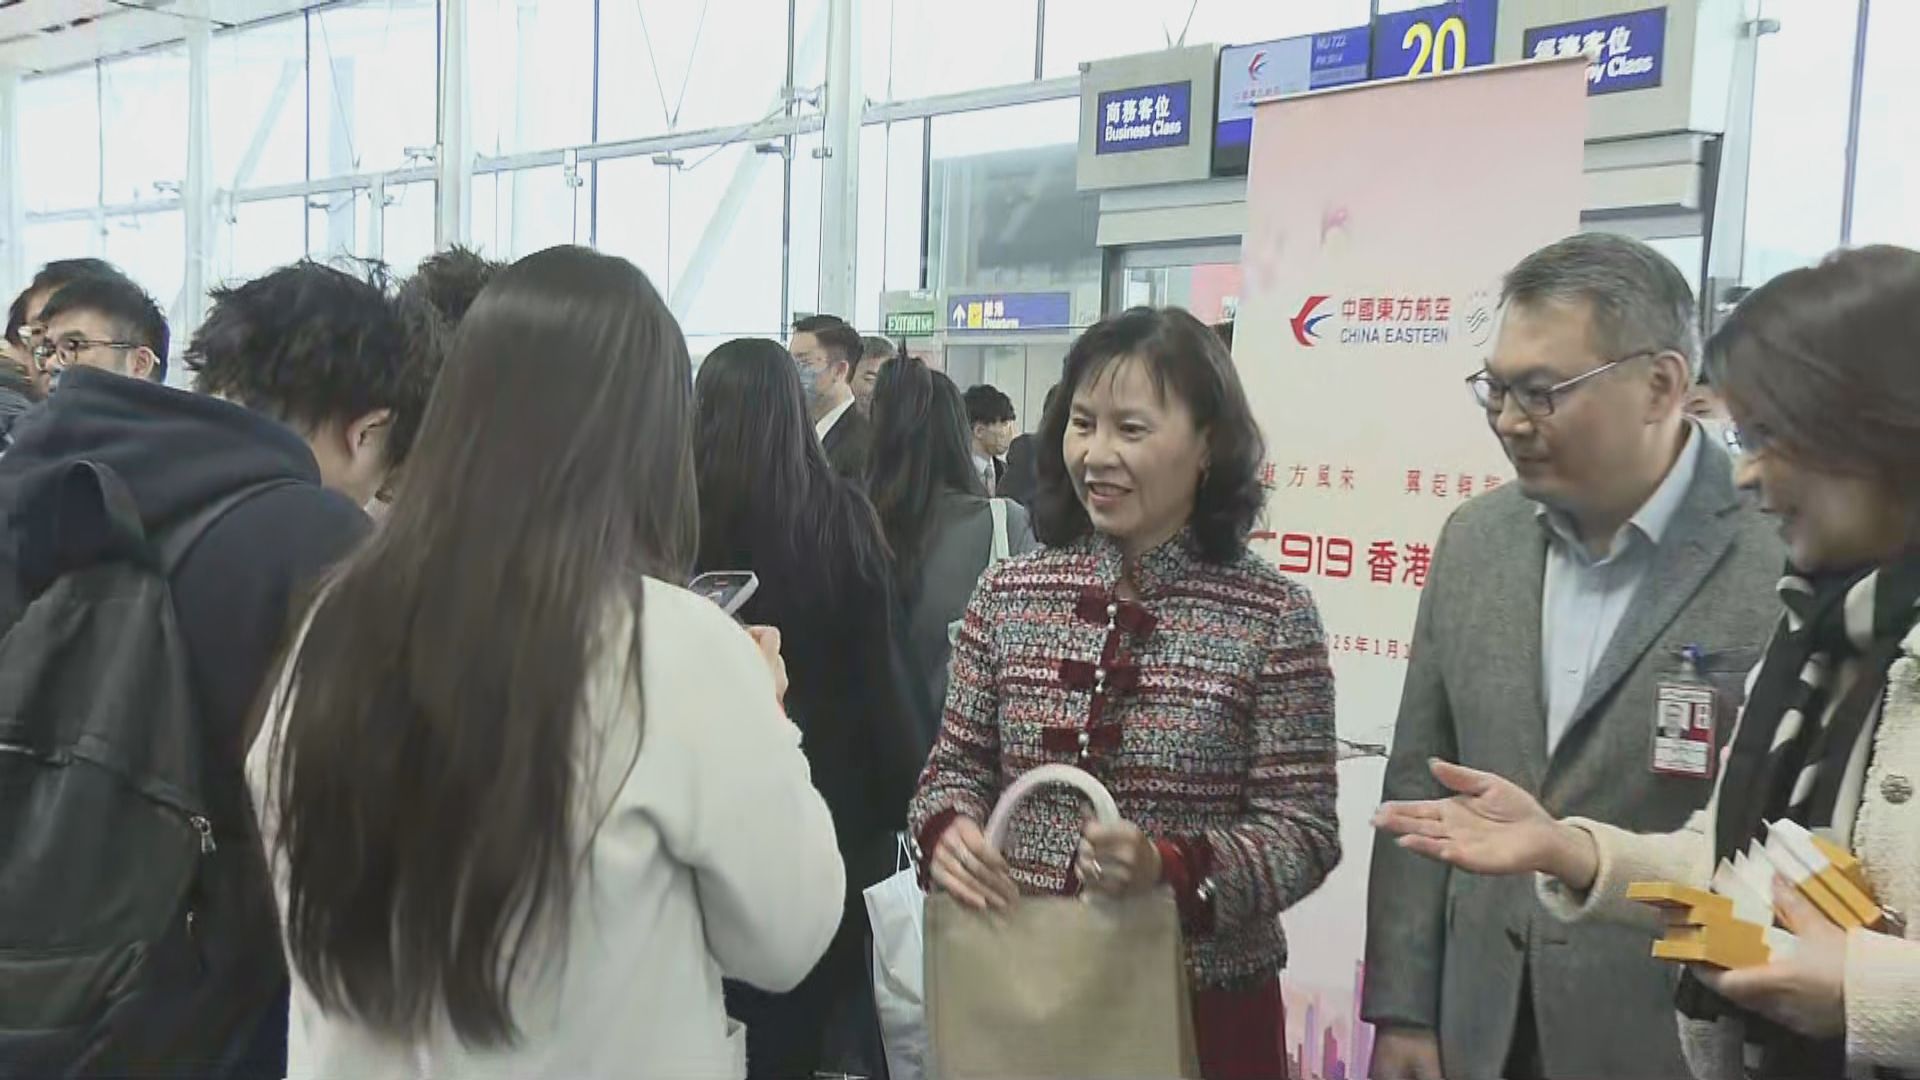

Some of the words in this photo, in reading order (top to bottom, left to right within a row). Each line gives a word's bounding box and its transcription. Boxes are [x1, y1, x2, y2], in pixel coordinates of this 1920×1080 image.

[1401, 17, 1466, 79] 20
[1607, 55, 1654, 78] Class
[1105, 94, 1171, 125] 商務客位
[1104, 124, 1152, 142] Business
[1152, 119, 1182, 137] Class
[1342, 298, 1451, 322] 中國東方航空
[1340, 328, 1380, 344] CHINA
[1385, 327, 1449, 344] EASTERN
[1248, 531, 1354, 578] 919
[1367, 540, 1431, 587] 香港
